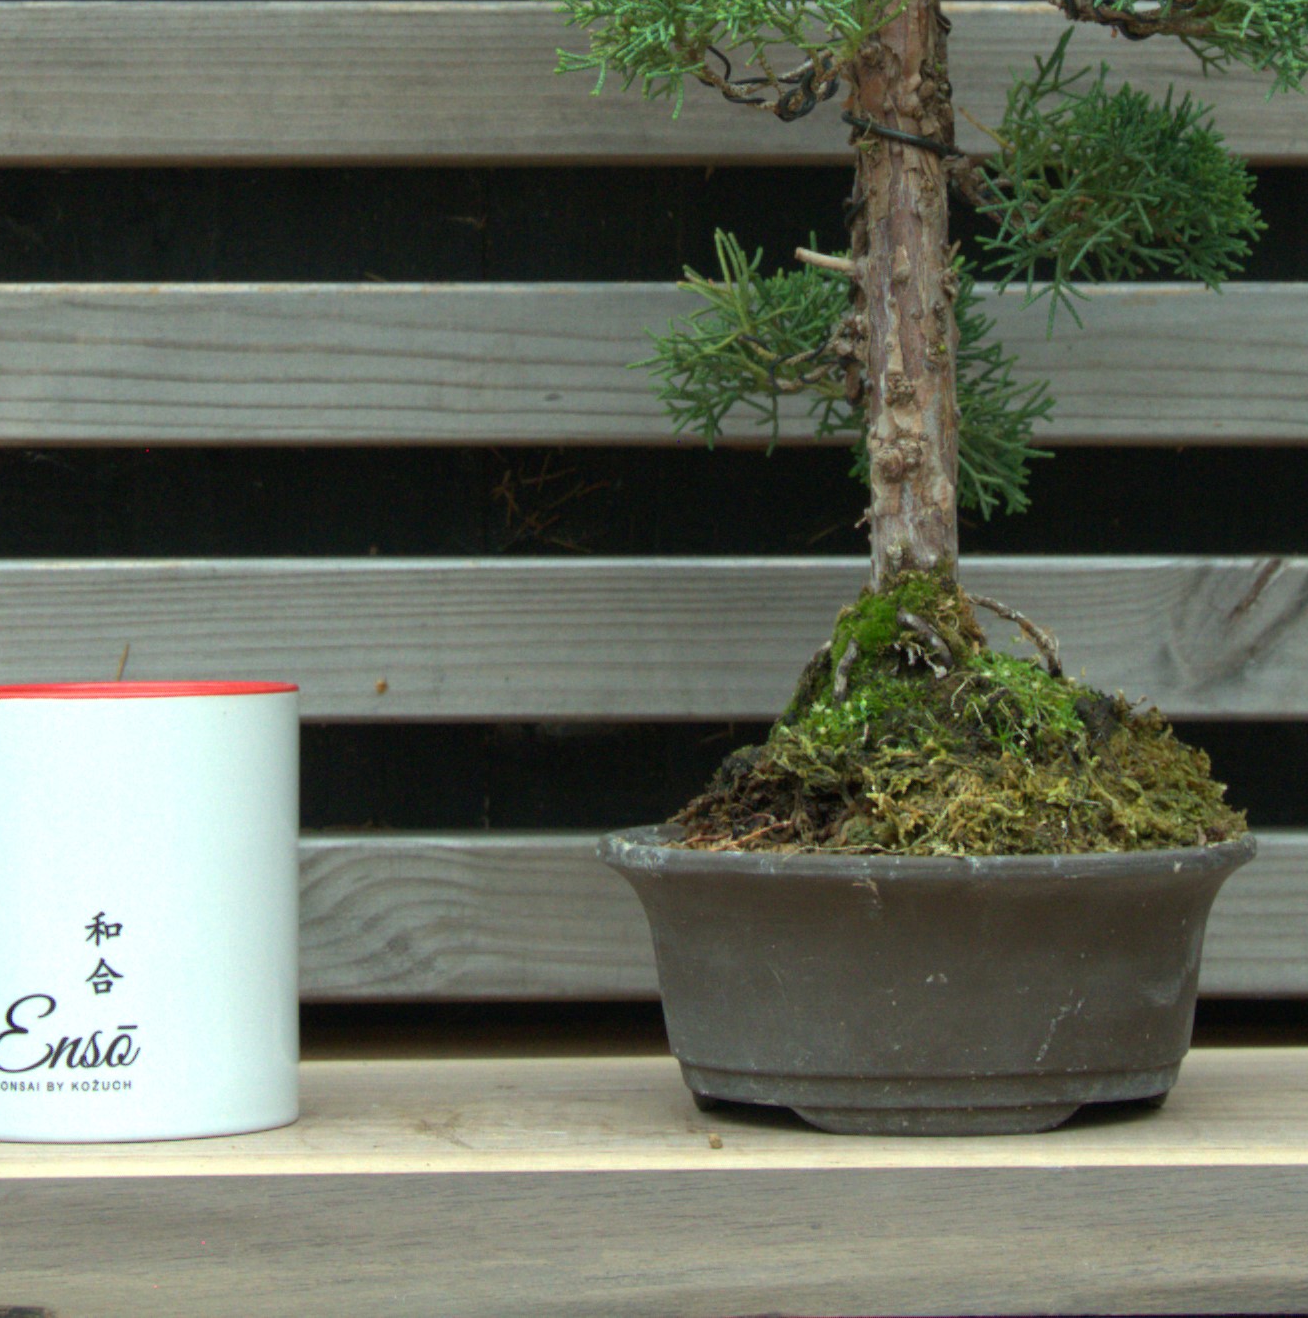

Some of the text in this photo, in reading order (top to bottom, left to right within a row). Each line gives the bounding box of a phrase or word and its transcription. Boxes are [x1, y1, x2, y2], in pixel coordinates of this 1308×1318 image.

[84, 911, 124, 995] 和合
[47, 1081, 64, 1092] BY
[71, 1078, 132, 1092] KOŽUCH
